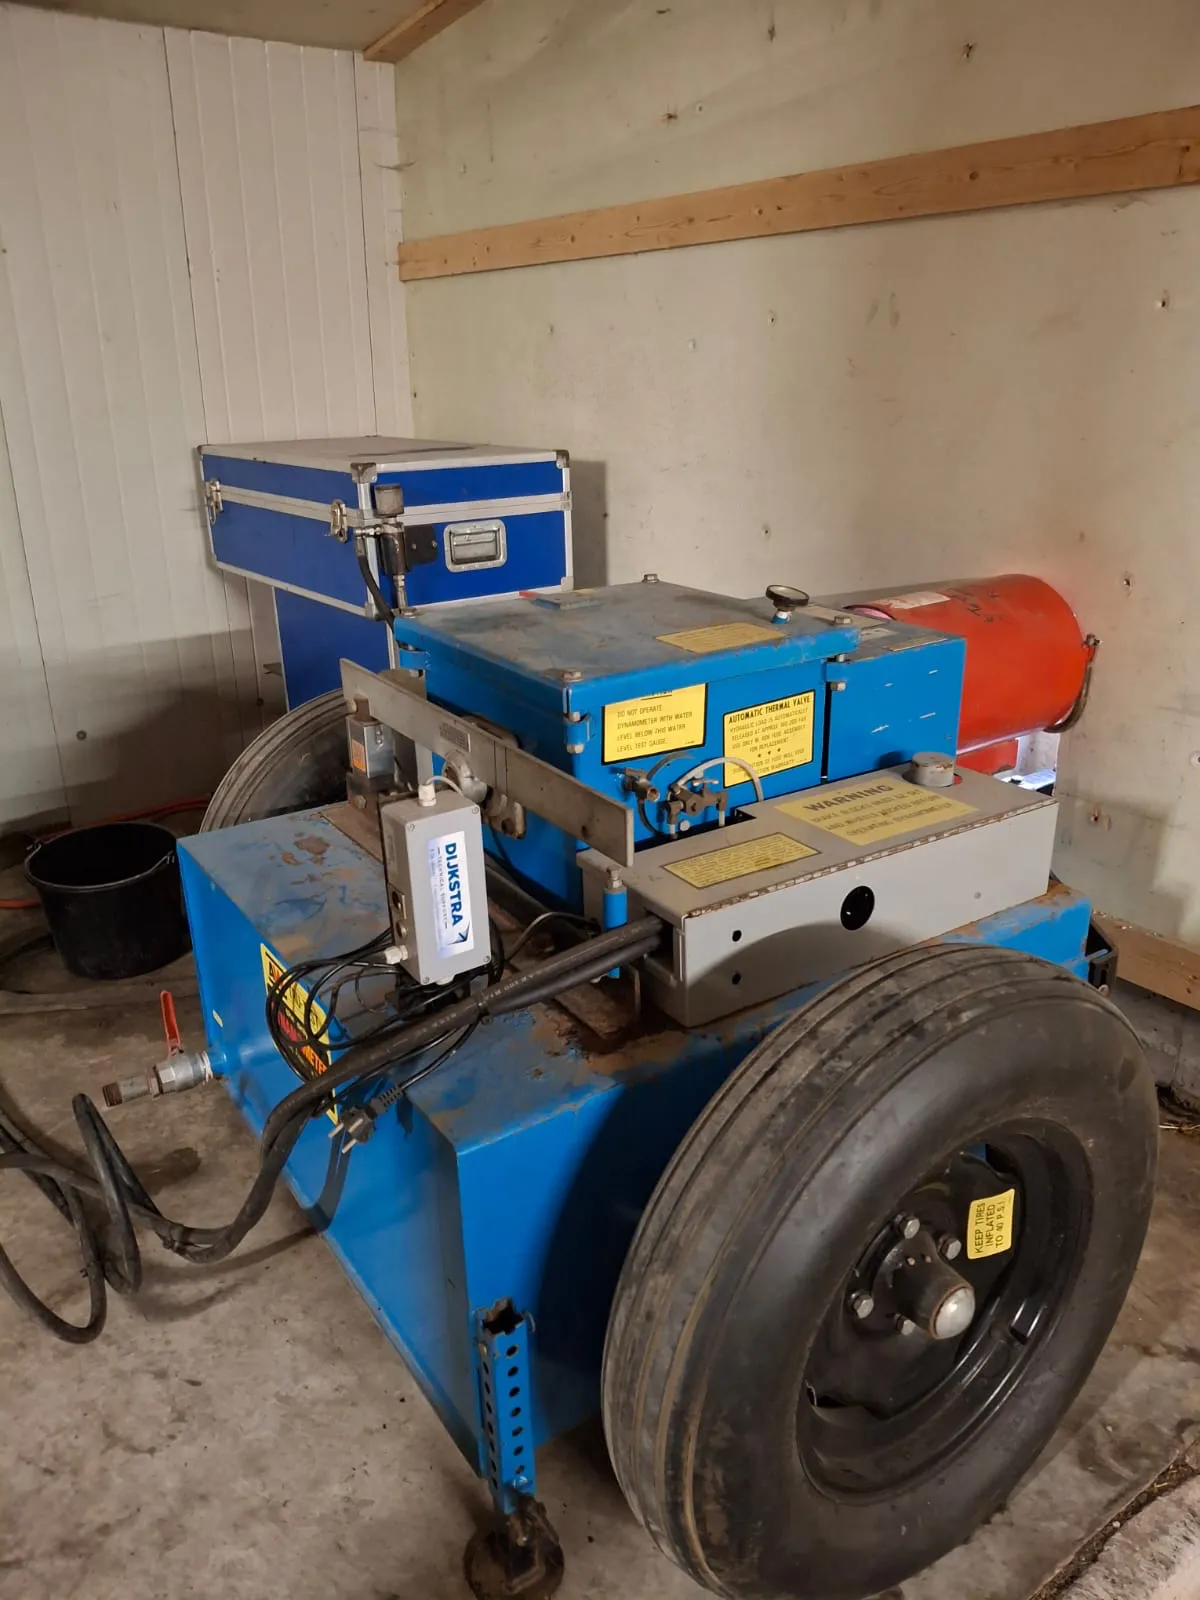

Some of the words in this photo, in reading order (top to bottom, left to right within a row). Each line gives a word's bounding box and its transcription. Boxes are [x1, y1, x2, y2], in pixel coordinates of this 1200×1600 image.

[617, 719, 658, 730] DYNAMOMETER
[660, 714, 673, 722] WITH
[675, 712, 693, 720] WATER
[640, 704, 662, 715] OPERATE
[728, 708, 762, 724] AUTOMATIC
[765, 701, 791, 714] THERMAL
[793, 696, 810, 707] VALVE
[616, 732, 633, 742] LEVEL
[635, 728, 653, 738] BELOW
[655, 726, 666, 735] THIS
[668, 724, 686, 733] WATER
[616, 744, 632, 753] LEVEL
[804, 784, 894, 812] WARNING
[445, 842, 464, 926] DIJKSTRA
[975, 1202, 986, 1226] TIRES
[986, 1204, 996, 1246] INFLATED
[975, 1228, 984, 1254] KEEP
[996, 1234, 1004, 1248] TO
